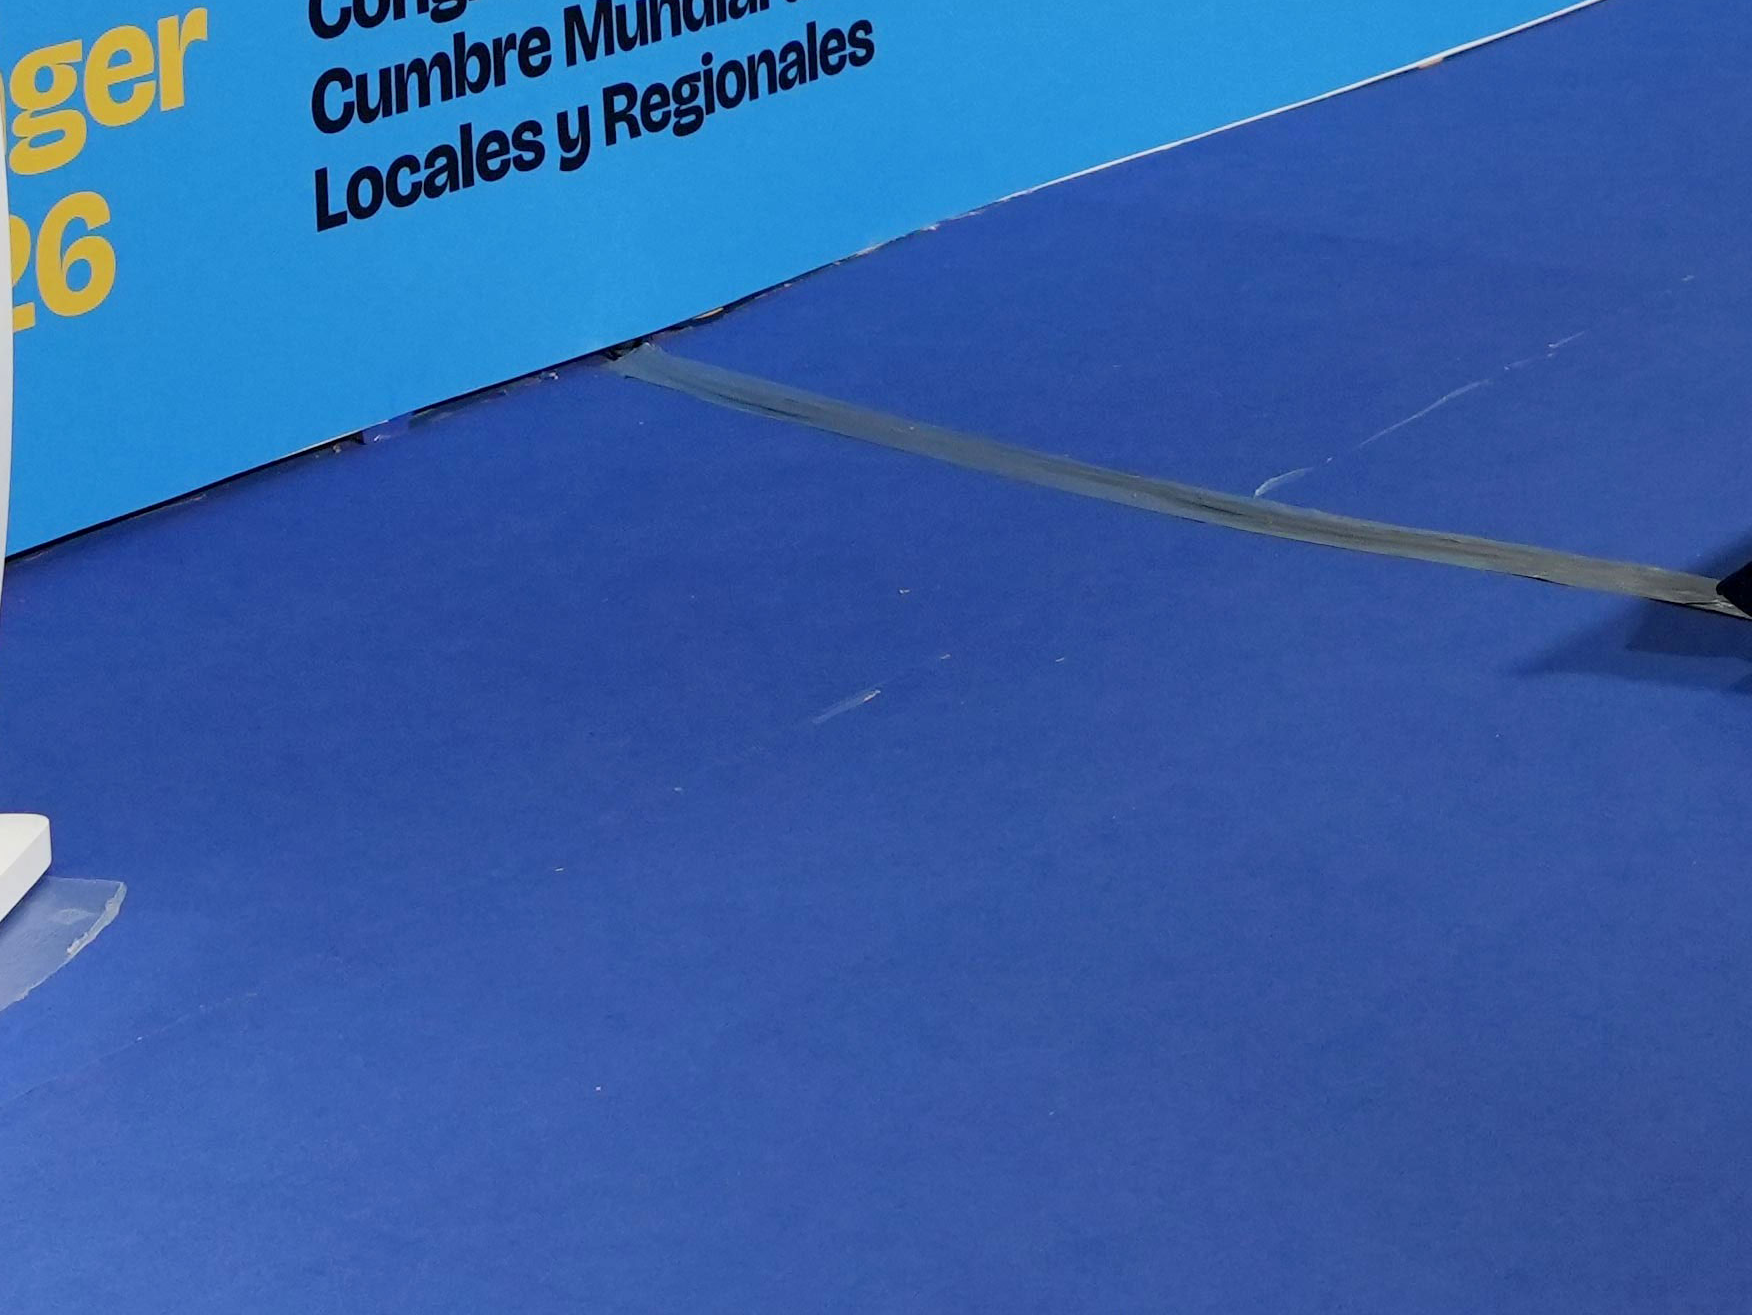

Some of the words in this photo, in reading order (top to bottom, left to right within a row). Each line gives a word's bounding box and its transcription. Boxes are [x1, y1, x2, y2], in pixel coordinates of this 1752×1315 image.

[310, 17, 553, 136] Cumbre
[314, 110, 546, 235] Locales
[555, 101, 593, 174] y
[601, 15, 877, 148] Regionales
